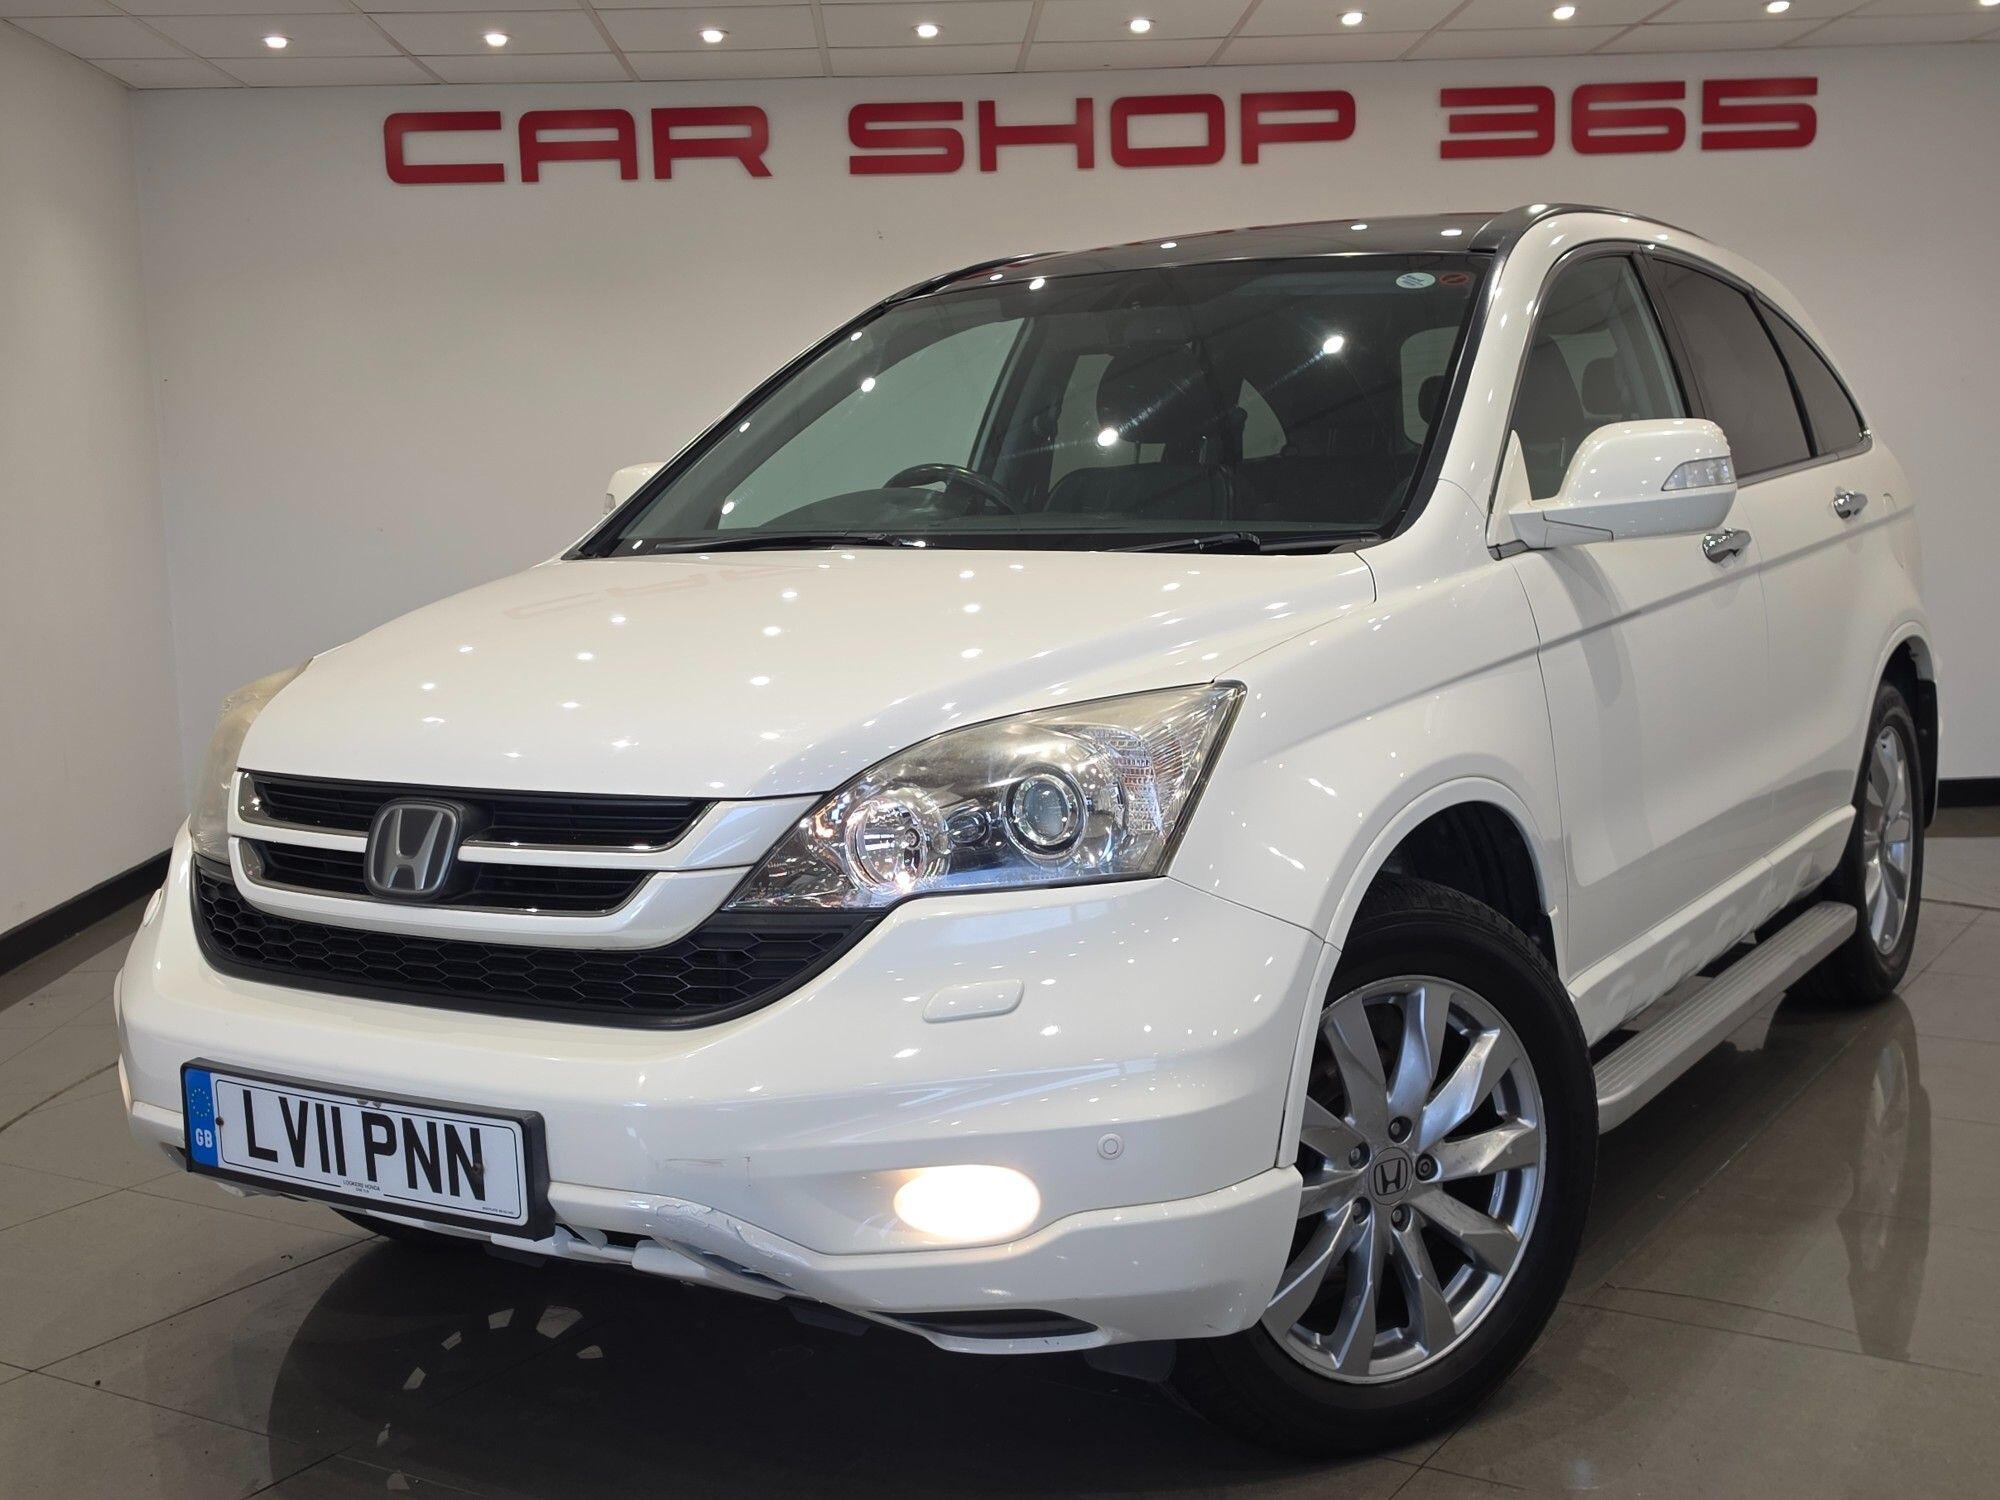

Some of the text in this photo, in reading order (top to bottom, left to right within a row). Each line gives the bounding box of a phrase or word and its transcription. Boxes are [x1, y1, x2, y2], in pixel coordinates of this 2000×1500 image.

[385, 79, 1817, 183] CAR SHOP 365
[195, 1127, 213, 1148] GB
[361, 1111, 485, 1201] PNN
